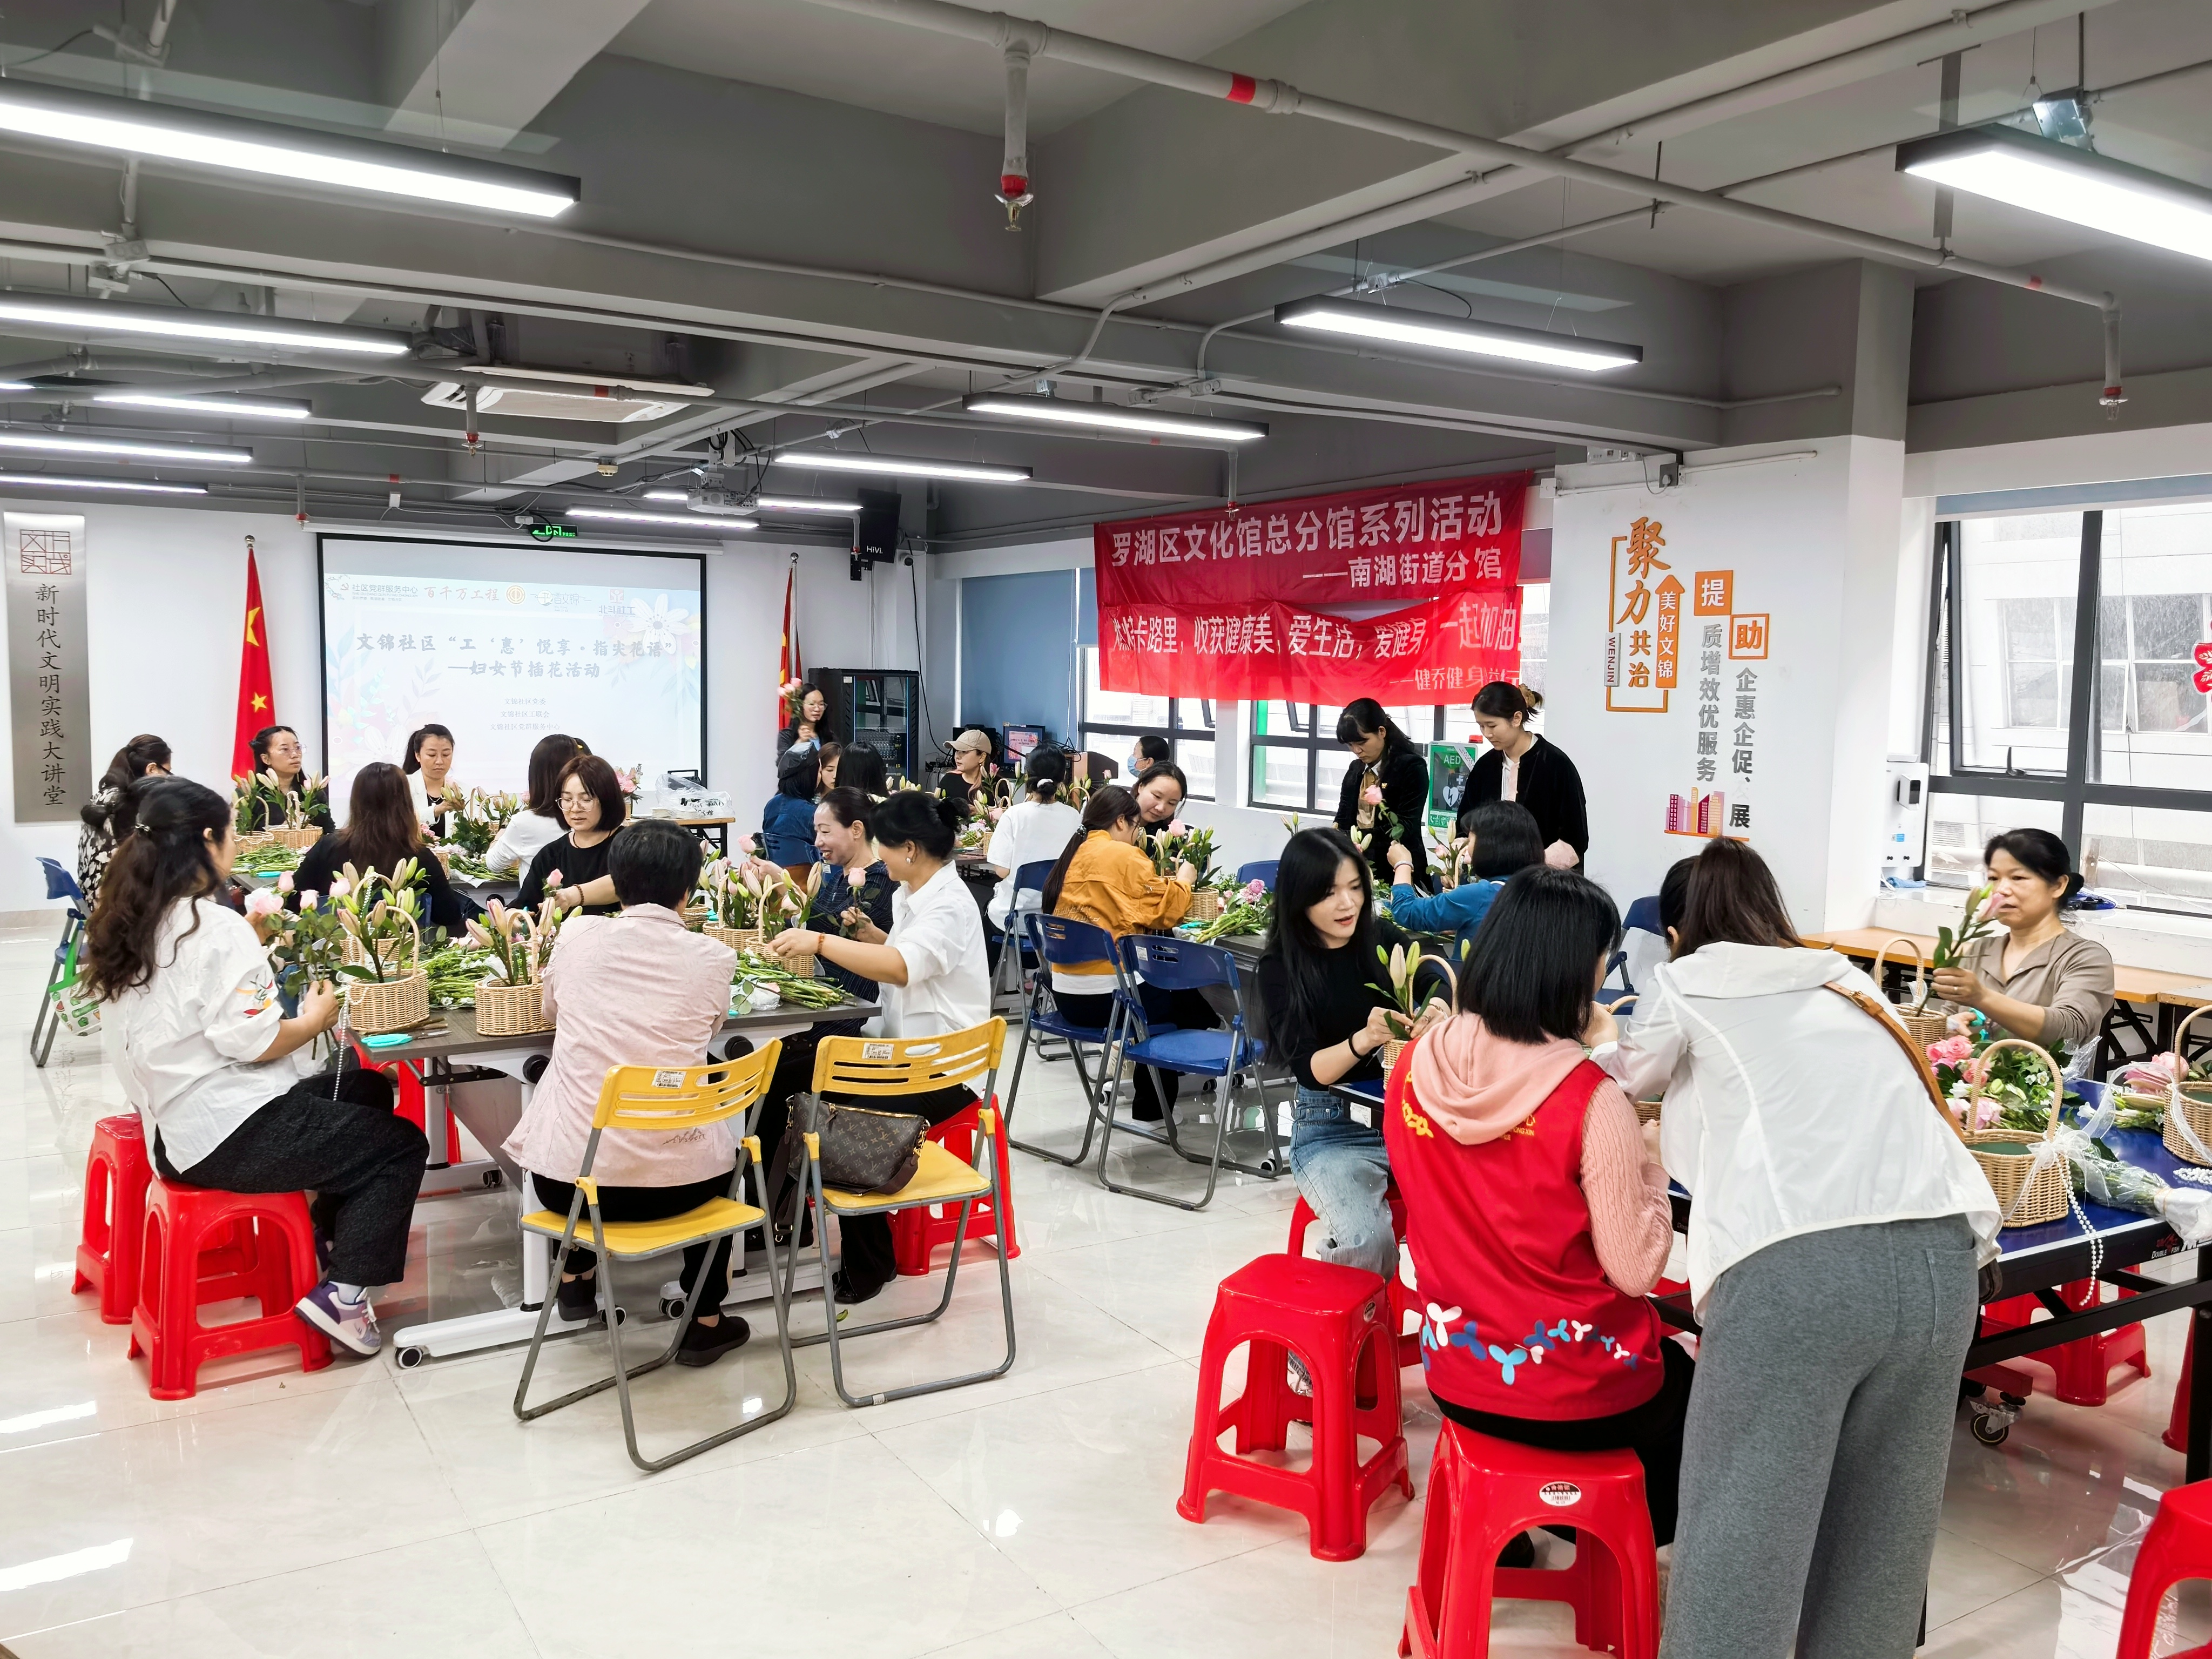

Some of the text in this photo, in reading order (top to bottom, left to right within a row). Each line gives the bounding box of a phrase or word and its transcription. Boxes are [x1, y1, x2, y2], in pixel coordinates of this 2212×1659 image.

[1111, 490, 1502, 568] 罗湖区文化馆总分馆系列活动
[352, 584, 418, 594] 社区党群服务中心
[424, 586, 500, 601] 百千万工程
[1657, 591, 1676, 679] 美好文锦
[1607, 636, 1616, 683] WENJIN
[35, 583, 66, 806] 新时代文明实践大讲堂
[1444, 754, 1461, 765] AED
